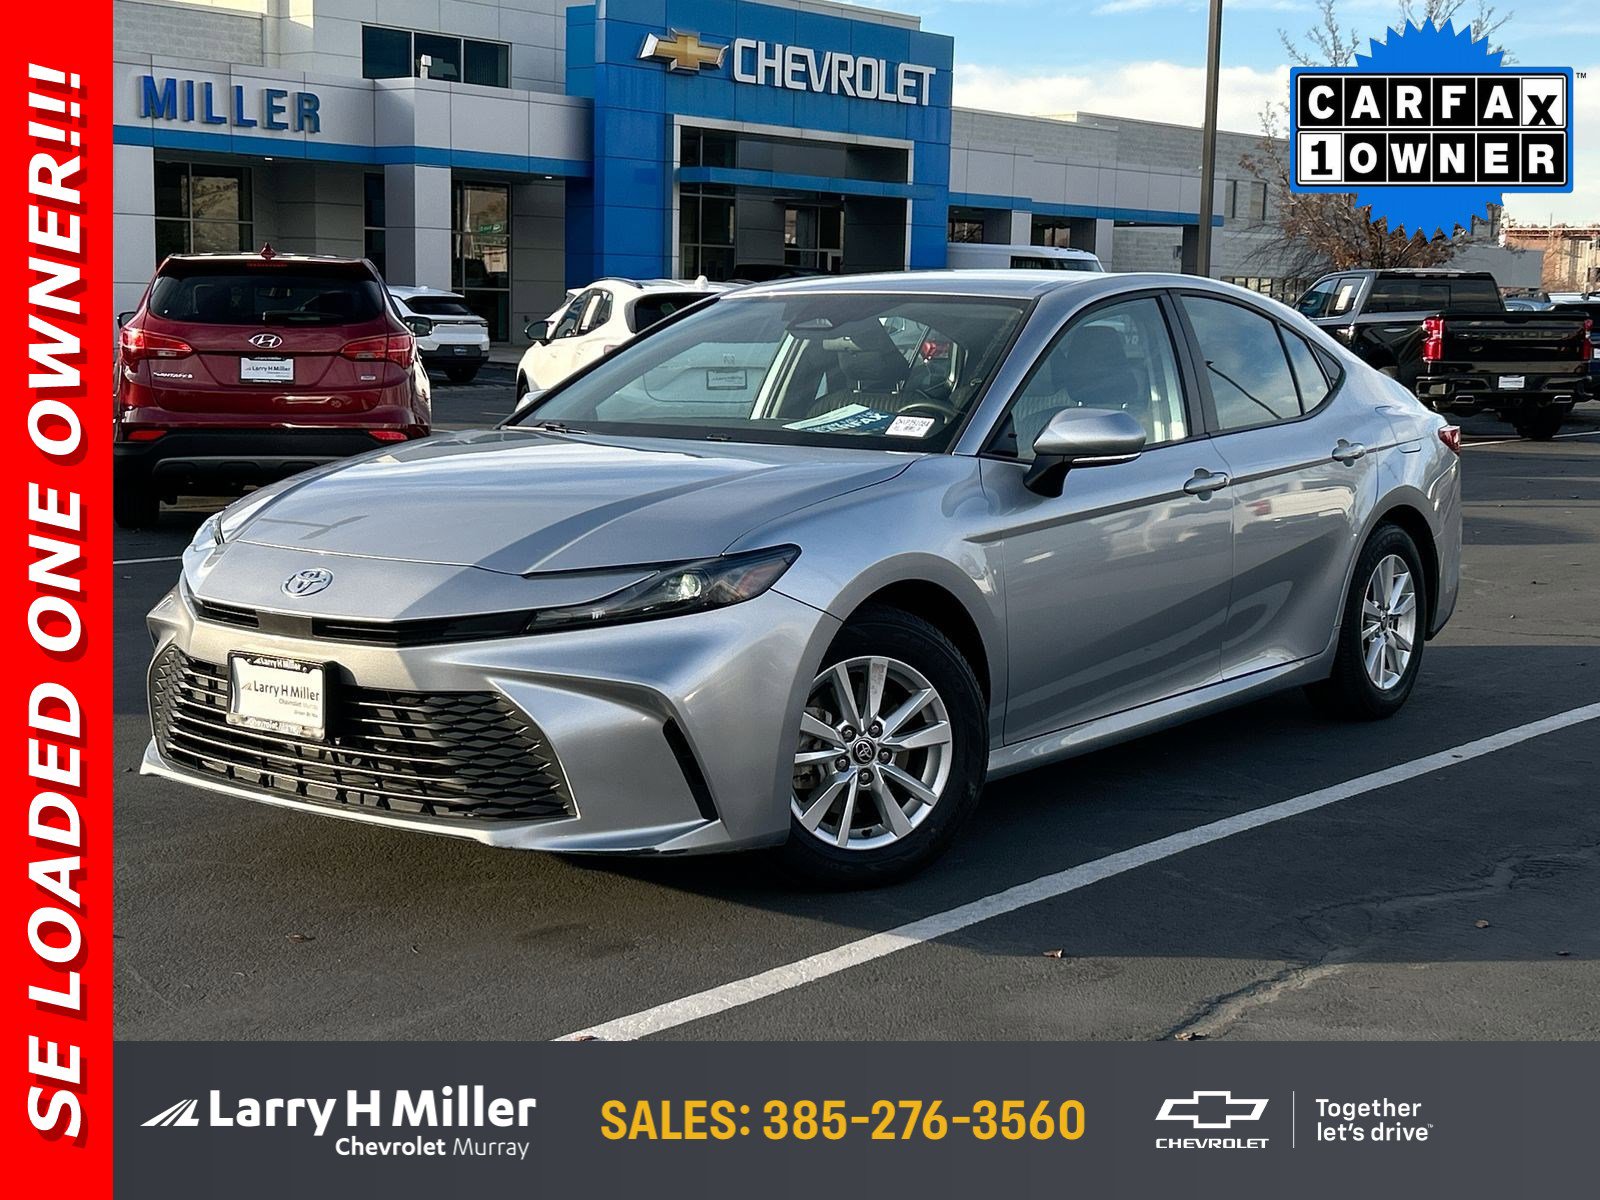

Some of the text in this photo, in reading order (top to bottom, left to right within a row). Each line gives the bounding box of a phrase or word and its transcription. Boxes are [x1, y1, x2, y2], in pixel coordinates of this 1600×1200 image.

[732, 37, 937, 106] CHEVROLET
[140, 75, 321, 133] MILLER
[253, 680, 320, 701] Larry H Miller
